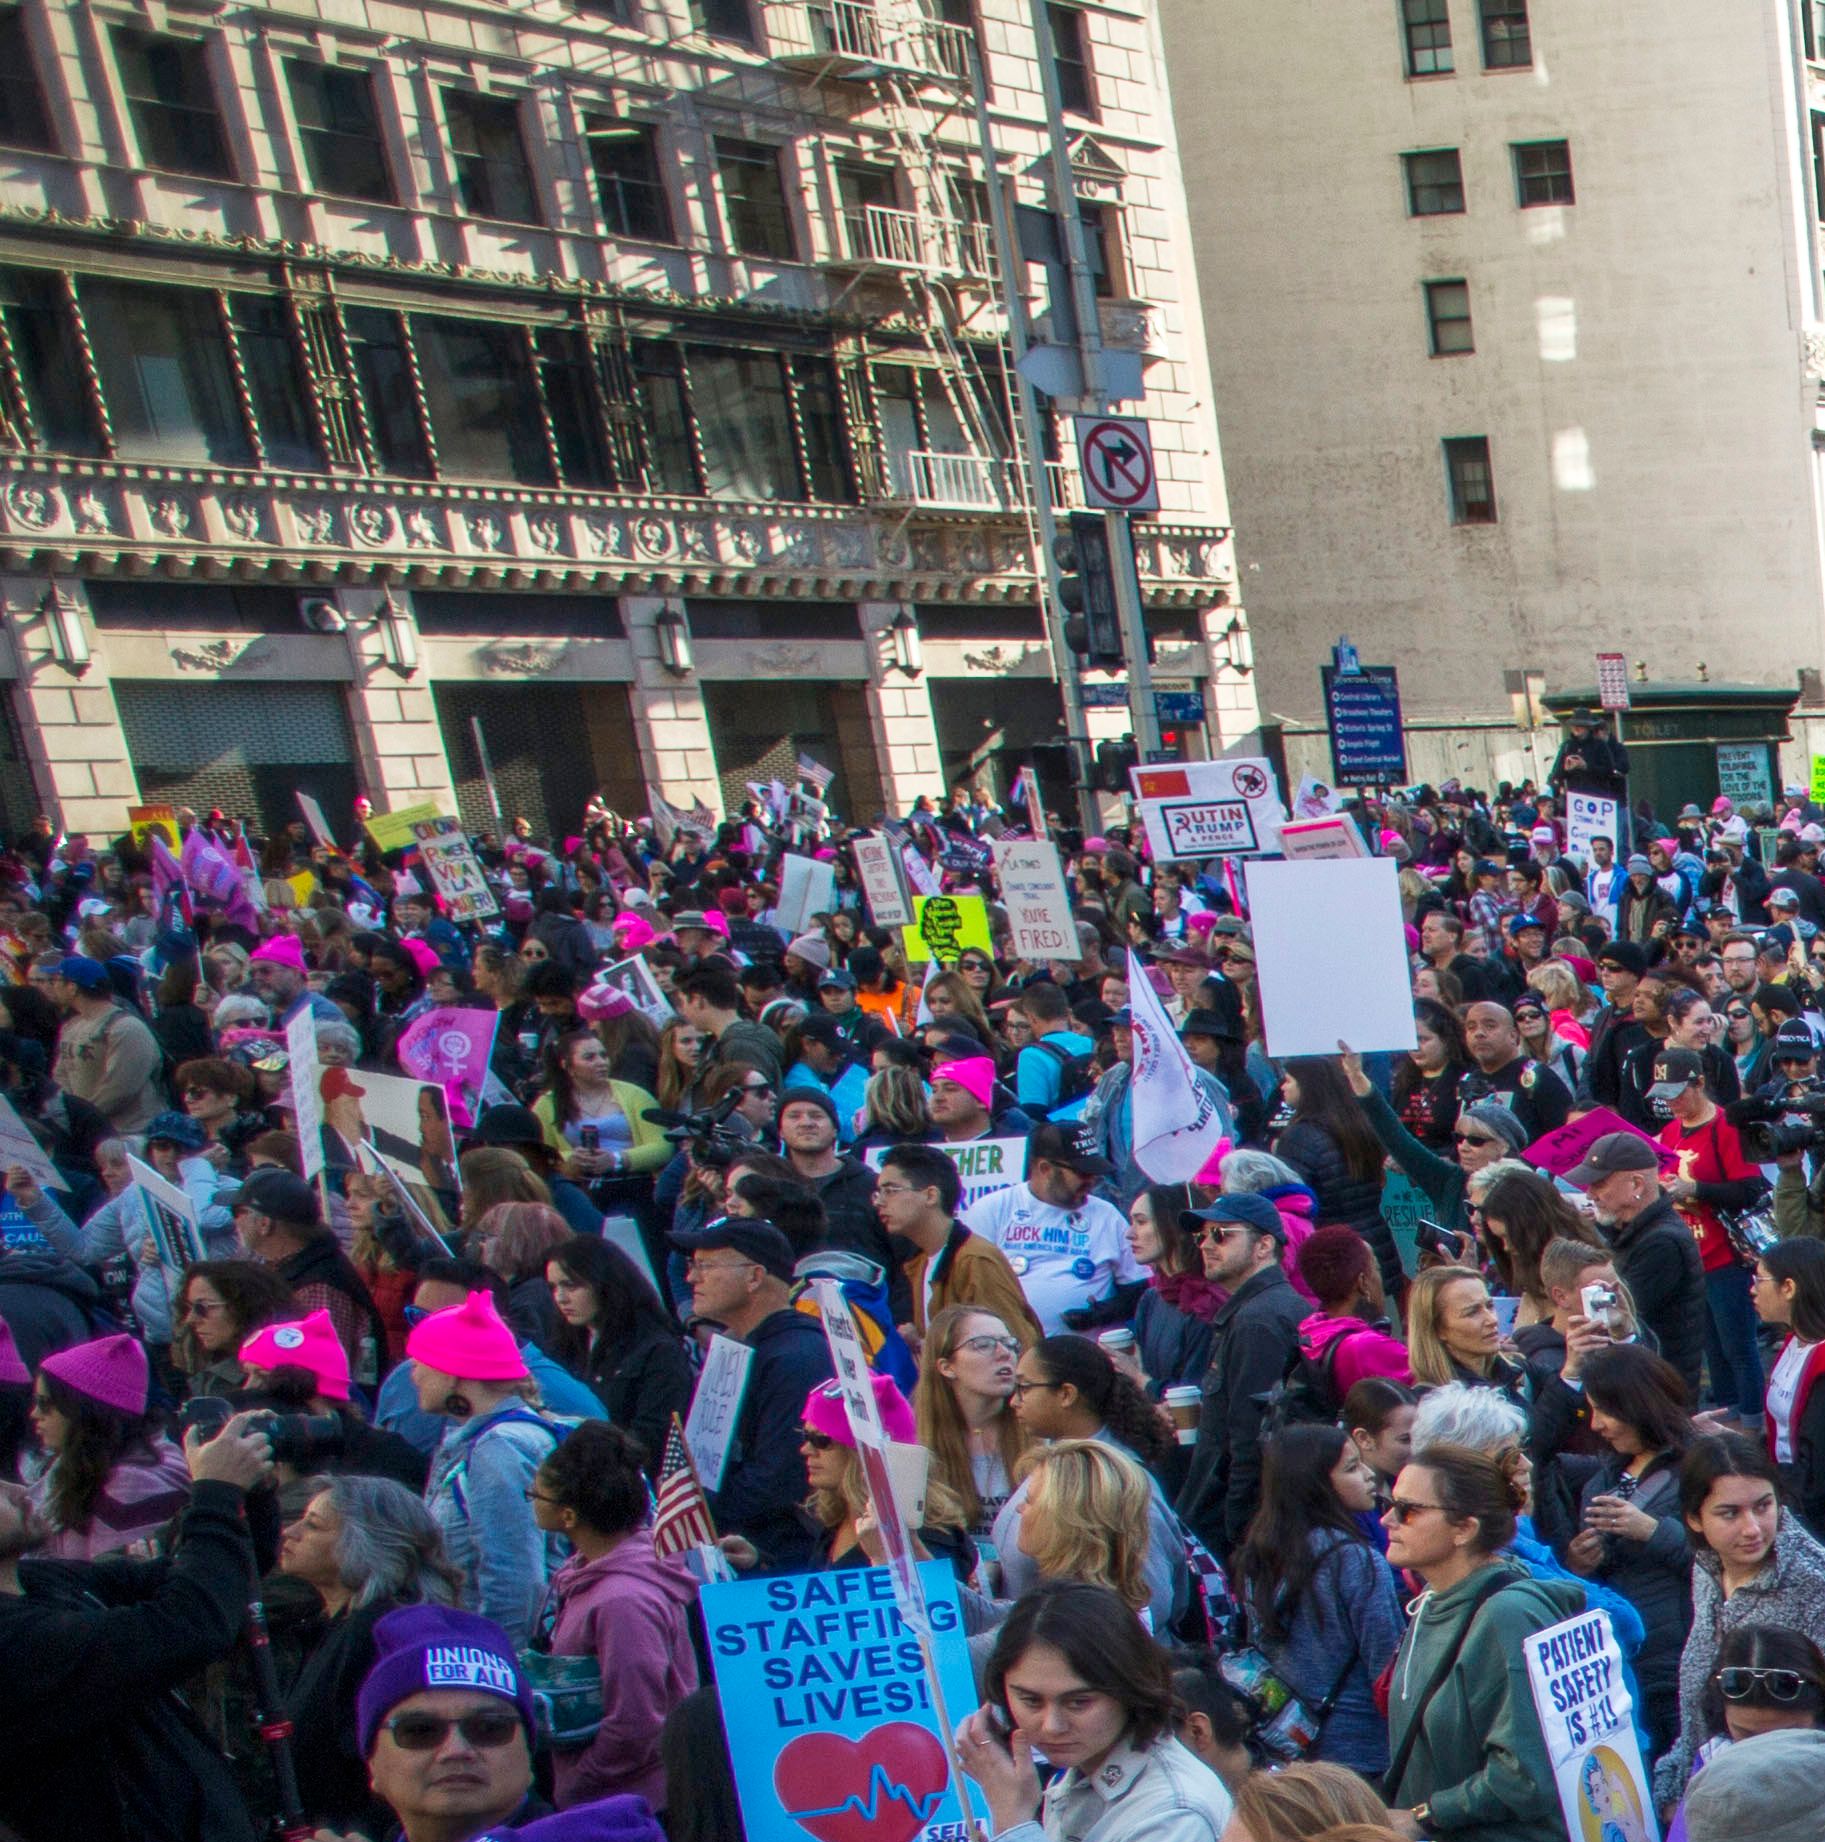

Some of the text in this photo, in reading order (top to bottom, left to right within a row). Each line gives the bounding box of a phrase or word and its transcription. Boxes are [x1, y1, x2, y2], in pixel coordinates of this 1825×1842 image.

[1004, 1225, 1090, 1249] LOCK HIM UP
[767, 1567, 892, 1612] SAFE
[714, 1599, 959, 1657] STAFFING
[1537, 1619, 1607, 1674] PATIENT
[430, 1646, 511, 1673] UNIONS
[430, 1664, 517, 1696] FOR ALL
[763, 1641, 928, 1690] SAVES
[773, 1677, 932, 1729] LIVES!
[1551, 1657, 1613, 1713] SAFETY
[1566, 1714, 1586, 1747] IS
